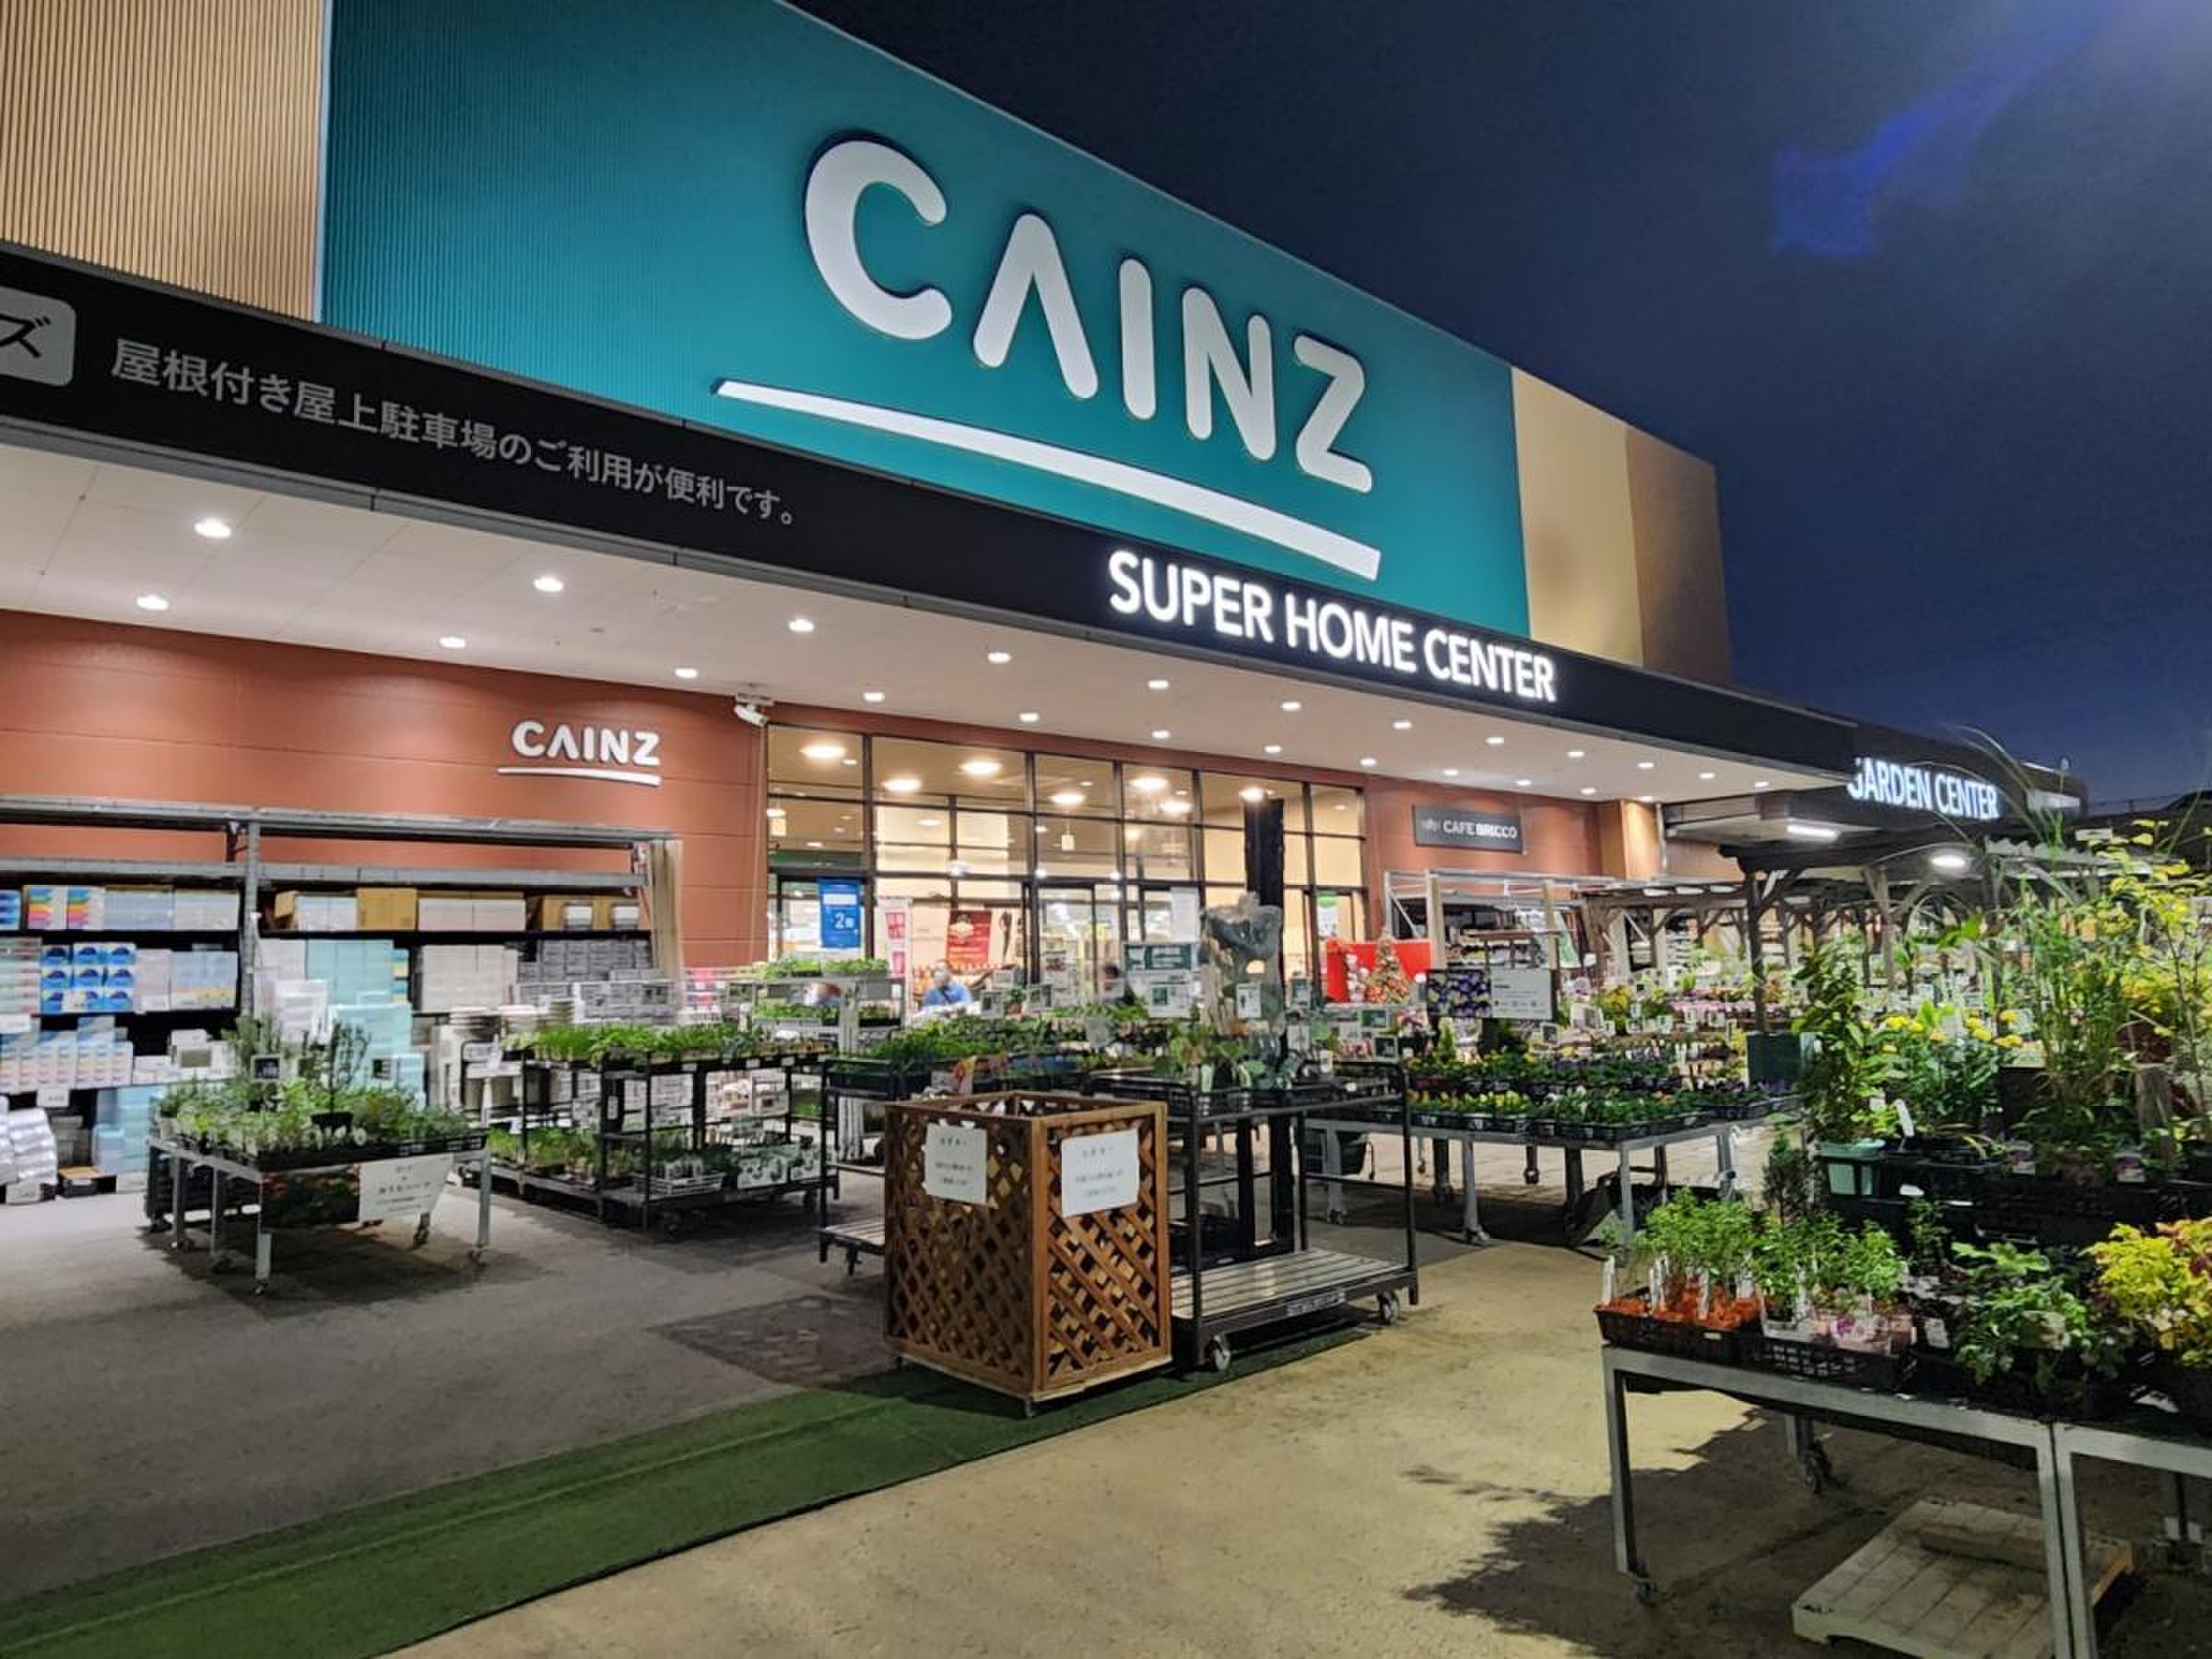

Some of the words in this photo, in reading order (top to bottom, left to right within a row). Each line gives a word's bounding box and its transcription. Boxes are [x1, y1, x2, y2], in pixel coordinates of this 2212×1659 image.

[806, 140, 1372, 493] CAINZ
[111, 338, 793, 525] 屋根付き屋上駐車場のご利用が便利です。
[1109, 549, 1275, 643] SUPER
[1285, 592, 1417, 674] HOME
[1423, 628, 1556, 702] CENTER
[512, 721, 660, 766] CAINZ
[1442, 819, 1476, 836] CAFE
[1936, 772, 1999, 819] CENTER
